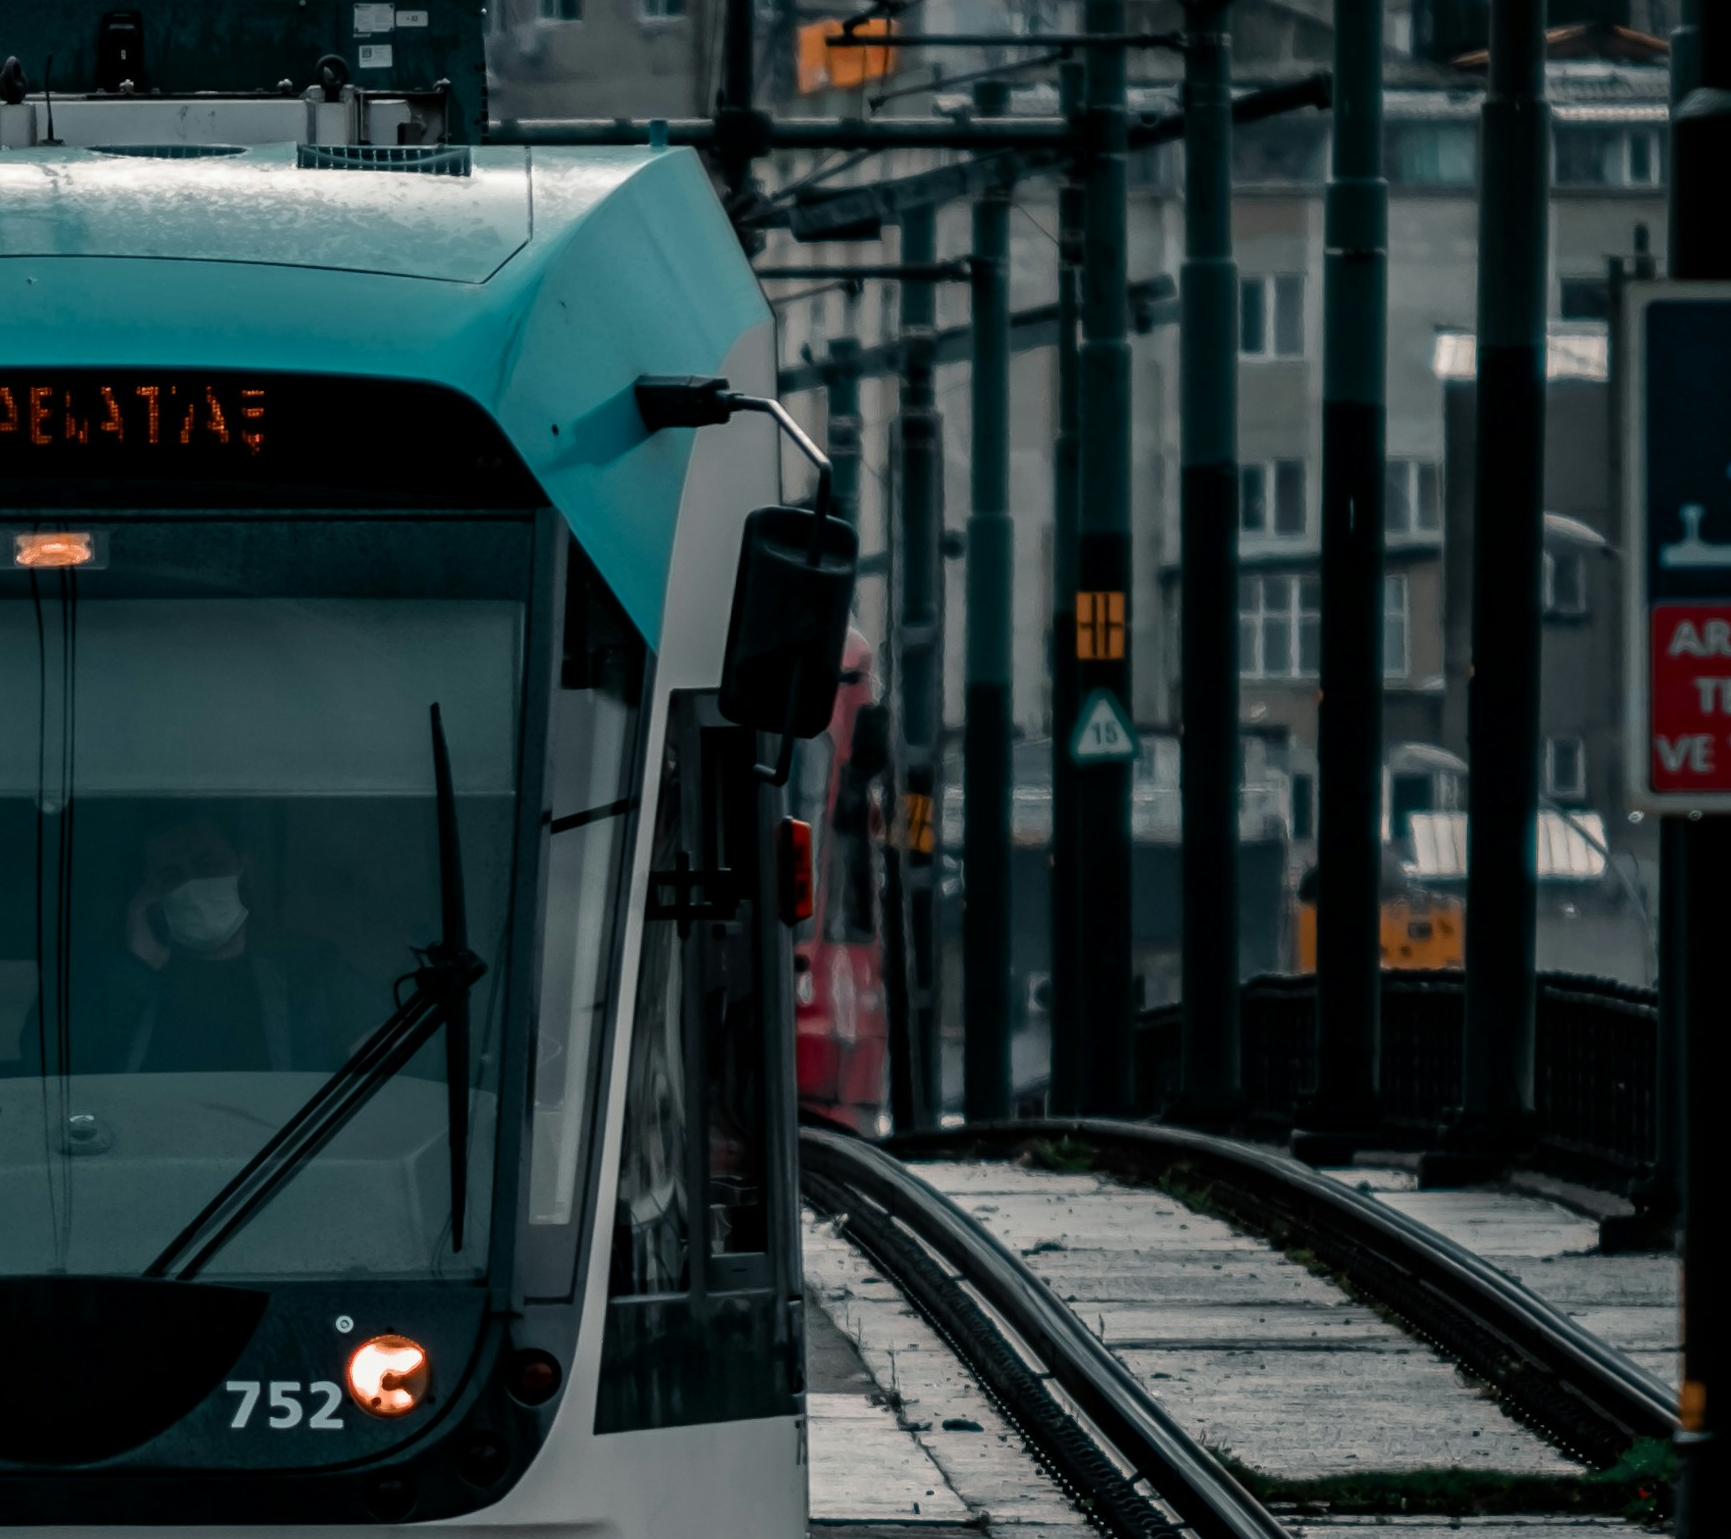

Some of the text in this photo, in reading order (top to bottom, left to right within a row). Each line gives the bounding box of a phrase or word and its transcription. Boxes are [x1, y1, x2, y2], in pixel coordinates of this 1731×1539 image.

[1090, 722, 1118, 745] 15
[1655, 733, 1716, 774] VE
[225, 1380, 345, 1430] 752
